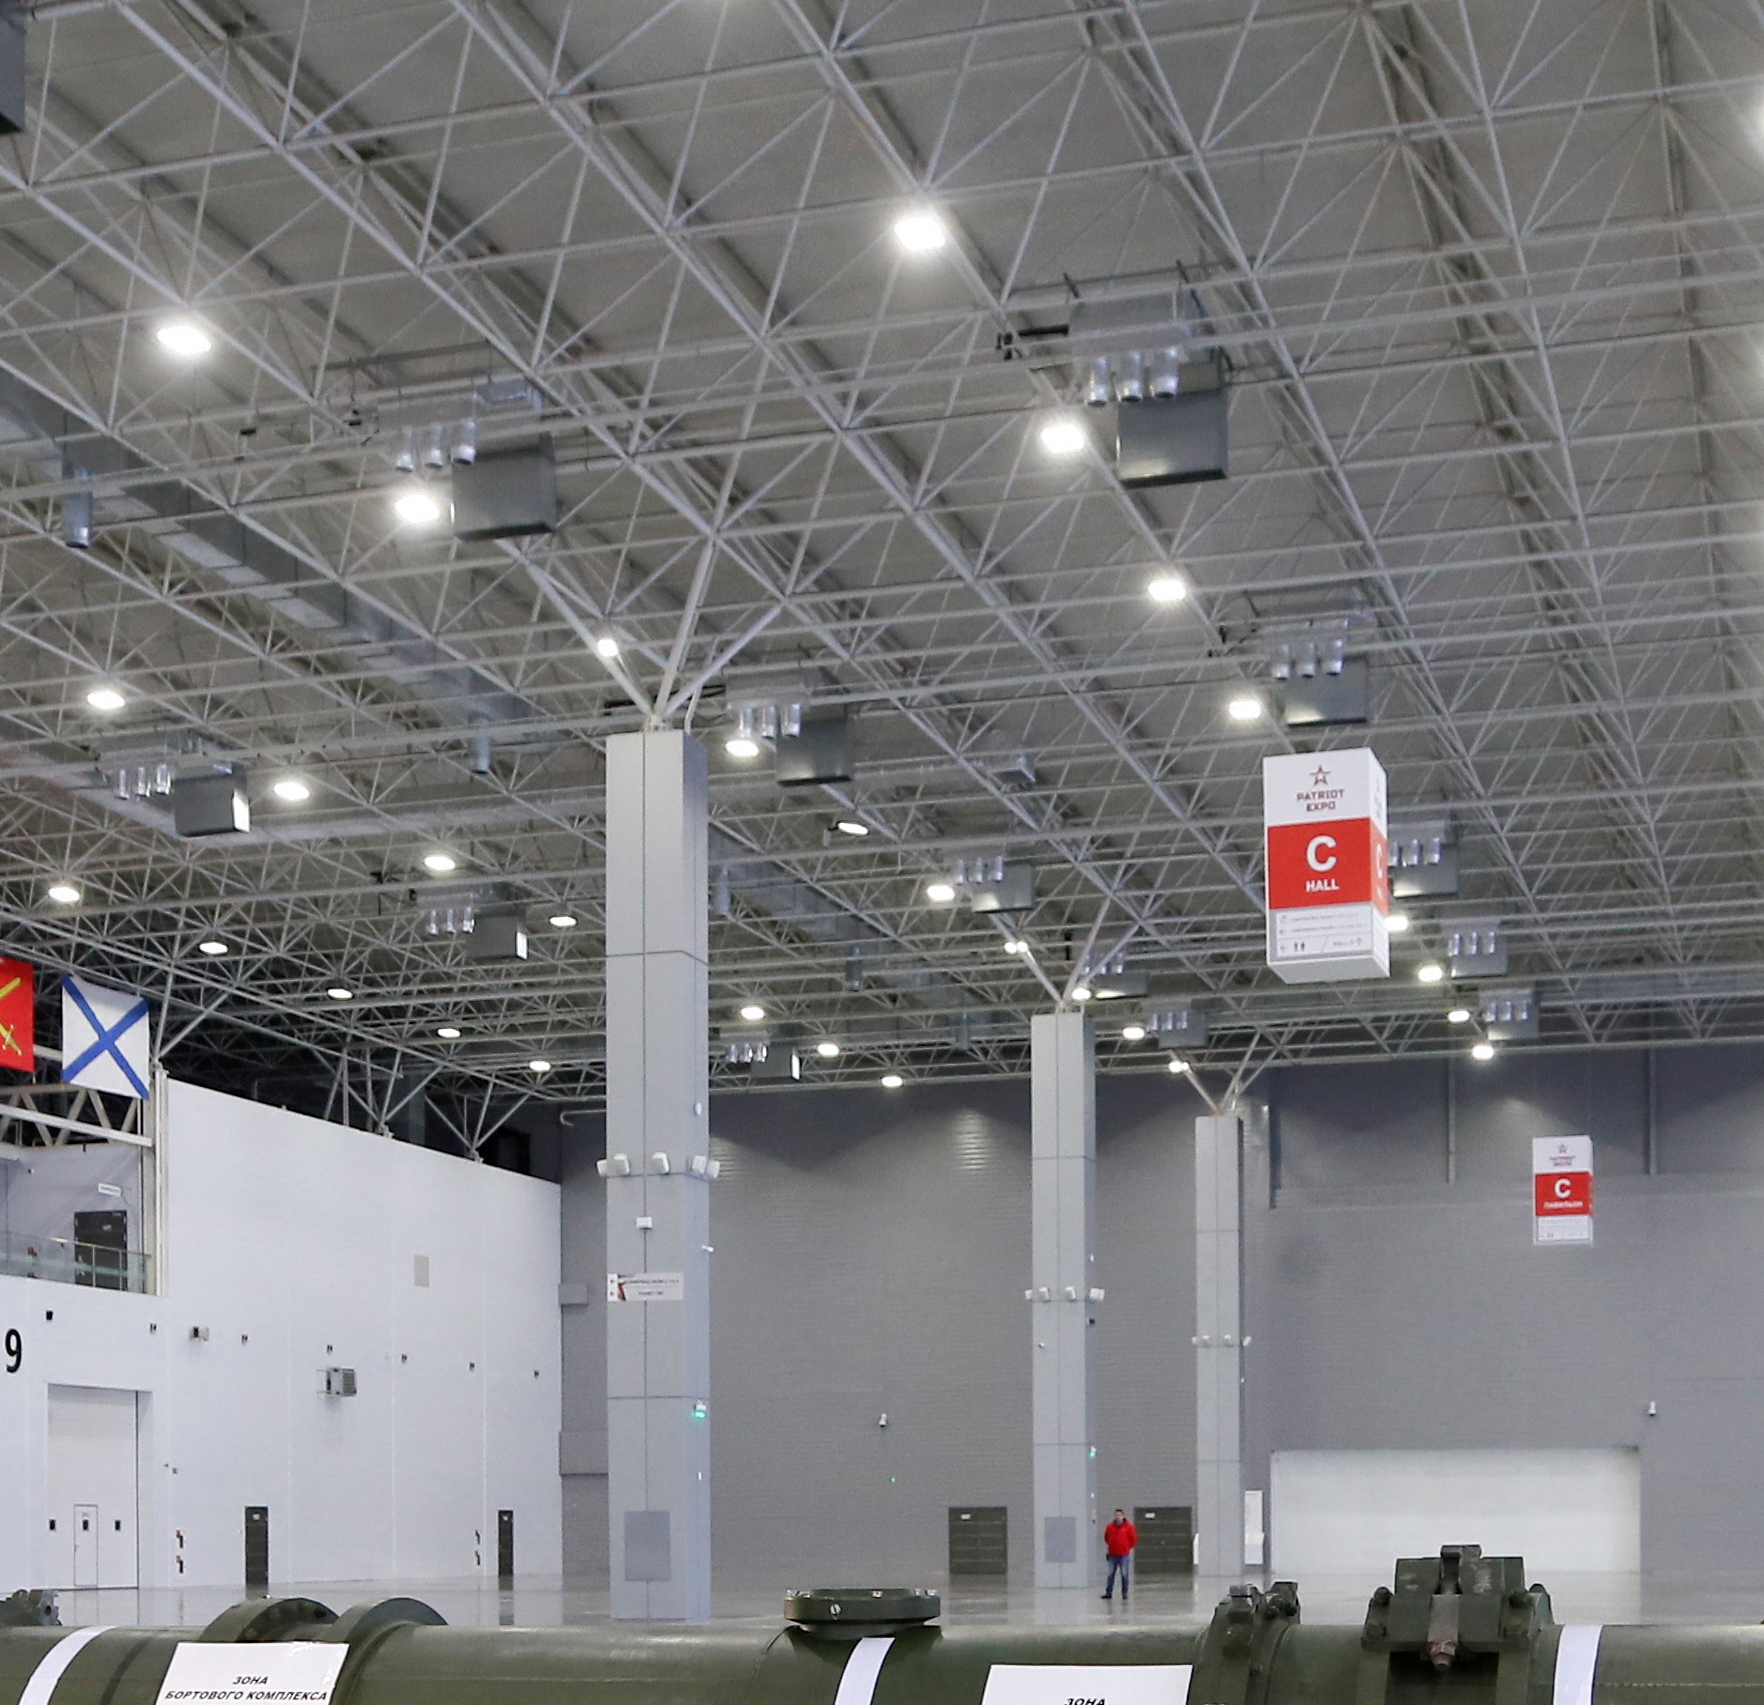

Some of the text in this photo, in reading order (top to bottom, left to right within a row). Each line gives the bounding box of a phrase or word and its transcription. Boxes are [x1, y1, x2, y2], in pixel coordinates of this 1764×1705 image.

[1296, 789, 1345, 801] PATRIOT
[1306, 801, 1336, 812] EXPO
[1306, 834, 1337, 873] C
[1306, 879, 1339, 893] HALL
[1555, 1178, 1571, 1199] C
[5, 1328, 21, 1373] 9
[232, 1676, 269, 1685] ЗОНА
[164, 1690, 328, 1701] БОРТОВОГО КОМПЛЕКСА
